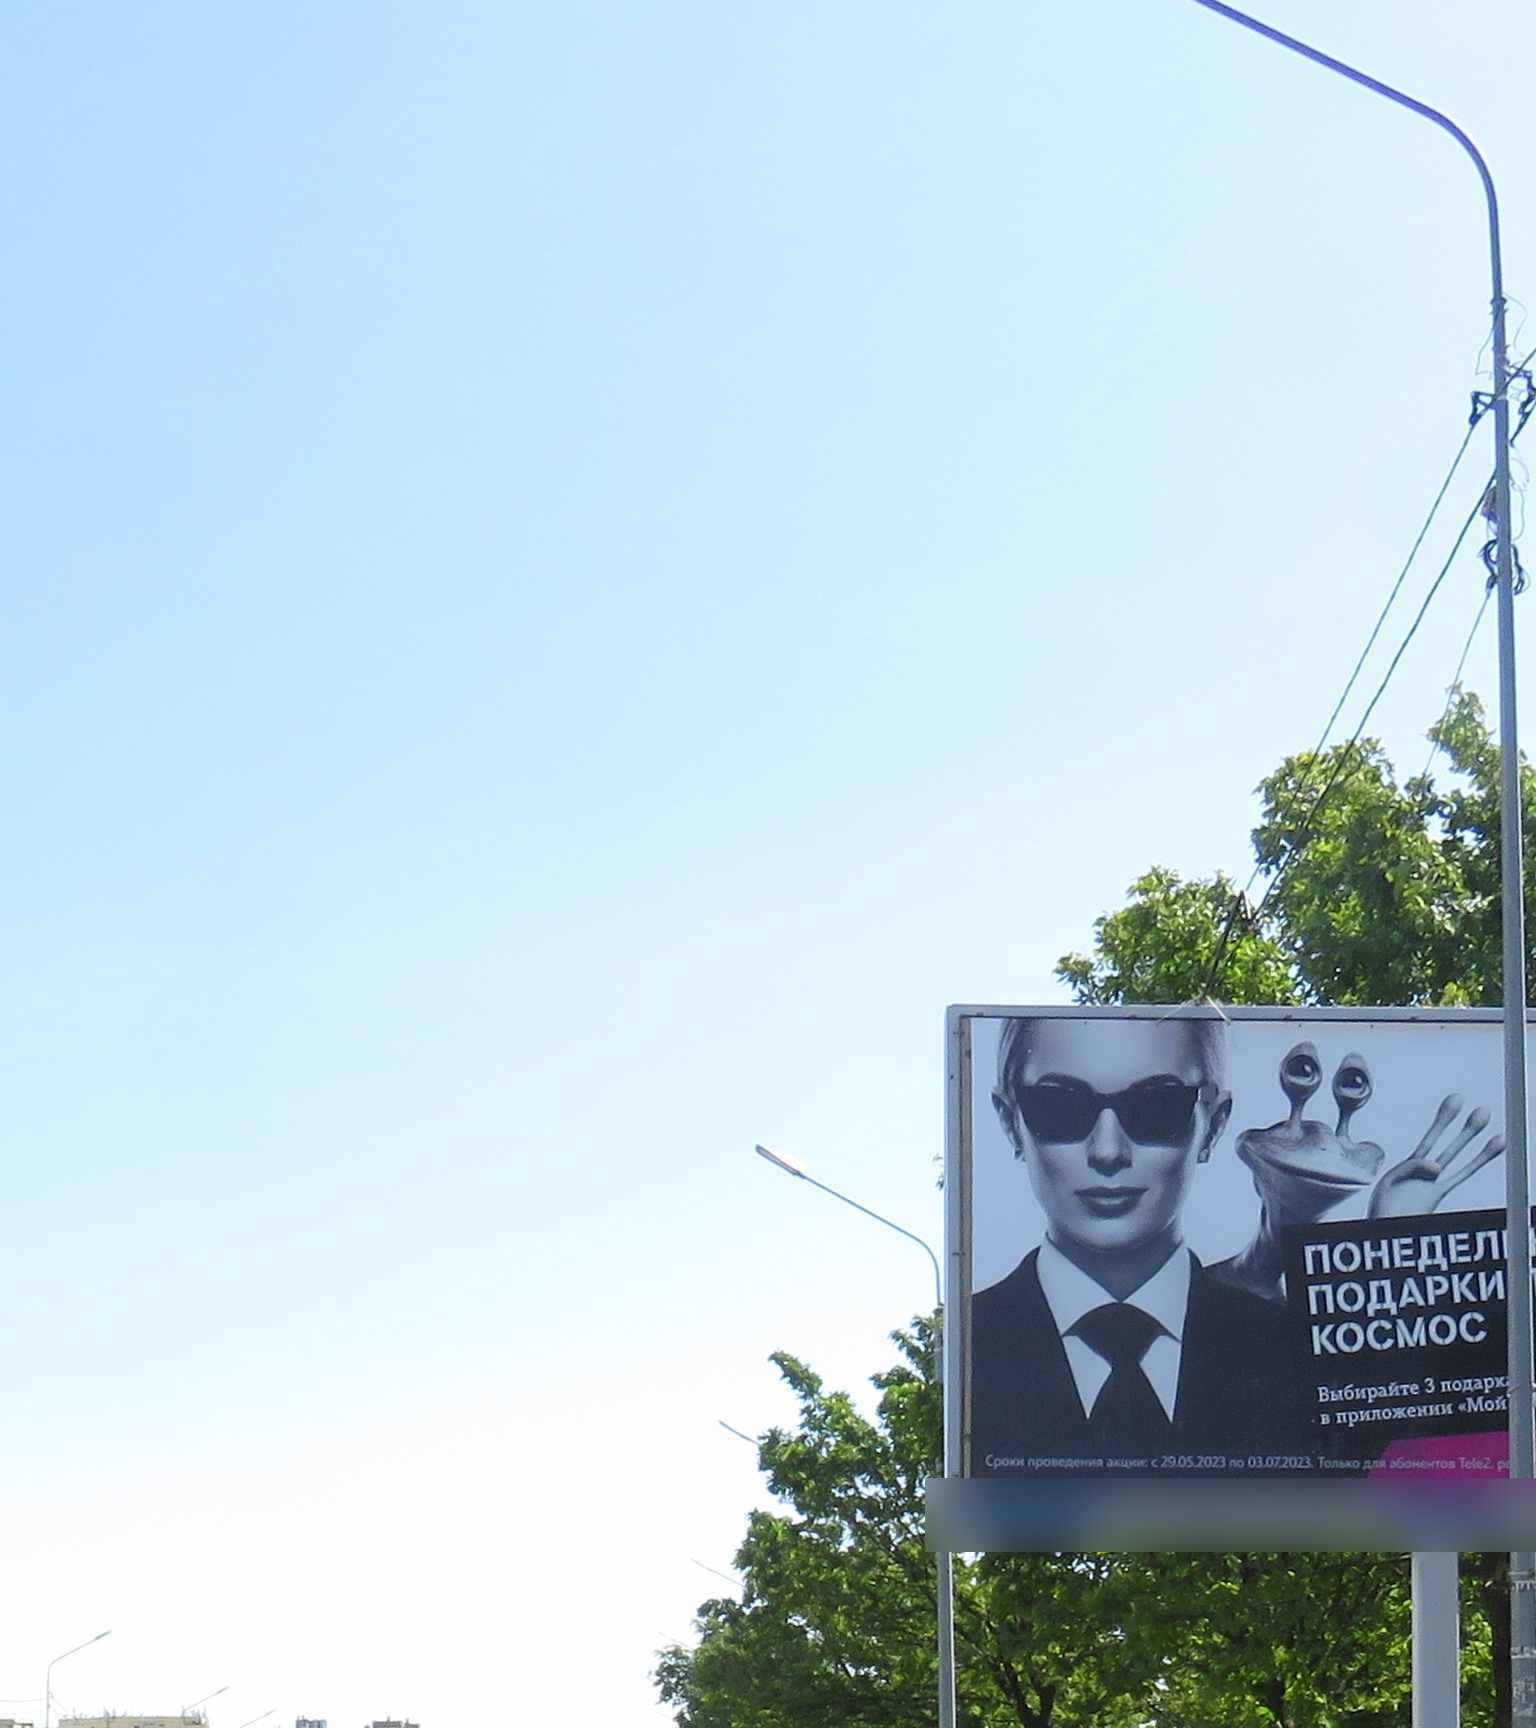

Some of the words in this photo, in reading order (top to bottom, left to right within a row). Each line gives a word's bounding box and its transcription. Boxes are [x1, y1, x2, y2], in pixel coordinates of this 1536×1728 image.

[1307, 1270, 1505, 1317] ПОДАРКИ
[1311, 1311, 1487, 1355] КОСМОС
[1317, 1378, 1419, 1402] Выбирайте
[1424, 1377, 1436, 1393] 3
[1320, 1412, 1330, 1425] в
[1336, 1402, 1453, 1427] приложении
[985, 1454, 1025, 1469] Сроки
[1027, 1457, 1104, 1469] проведения
[1106, 1457, 1148, 1469] акции:
[1151, 1459, 1158, 1468] с
[1160, 1455, 1226, 1468] 29.05.2023
[1230, 1459, 1245, 1468] по
[1318, 1456, 1360, 1469] Только
[1364, 1459, 1387, 1470] для
[1389, 1457, 1455, 1469] абонентов
